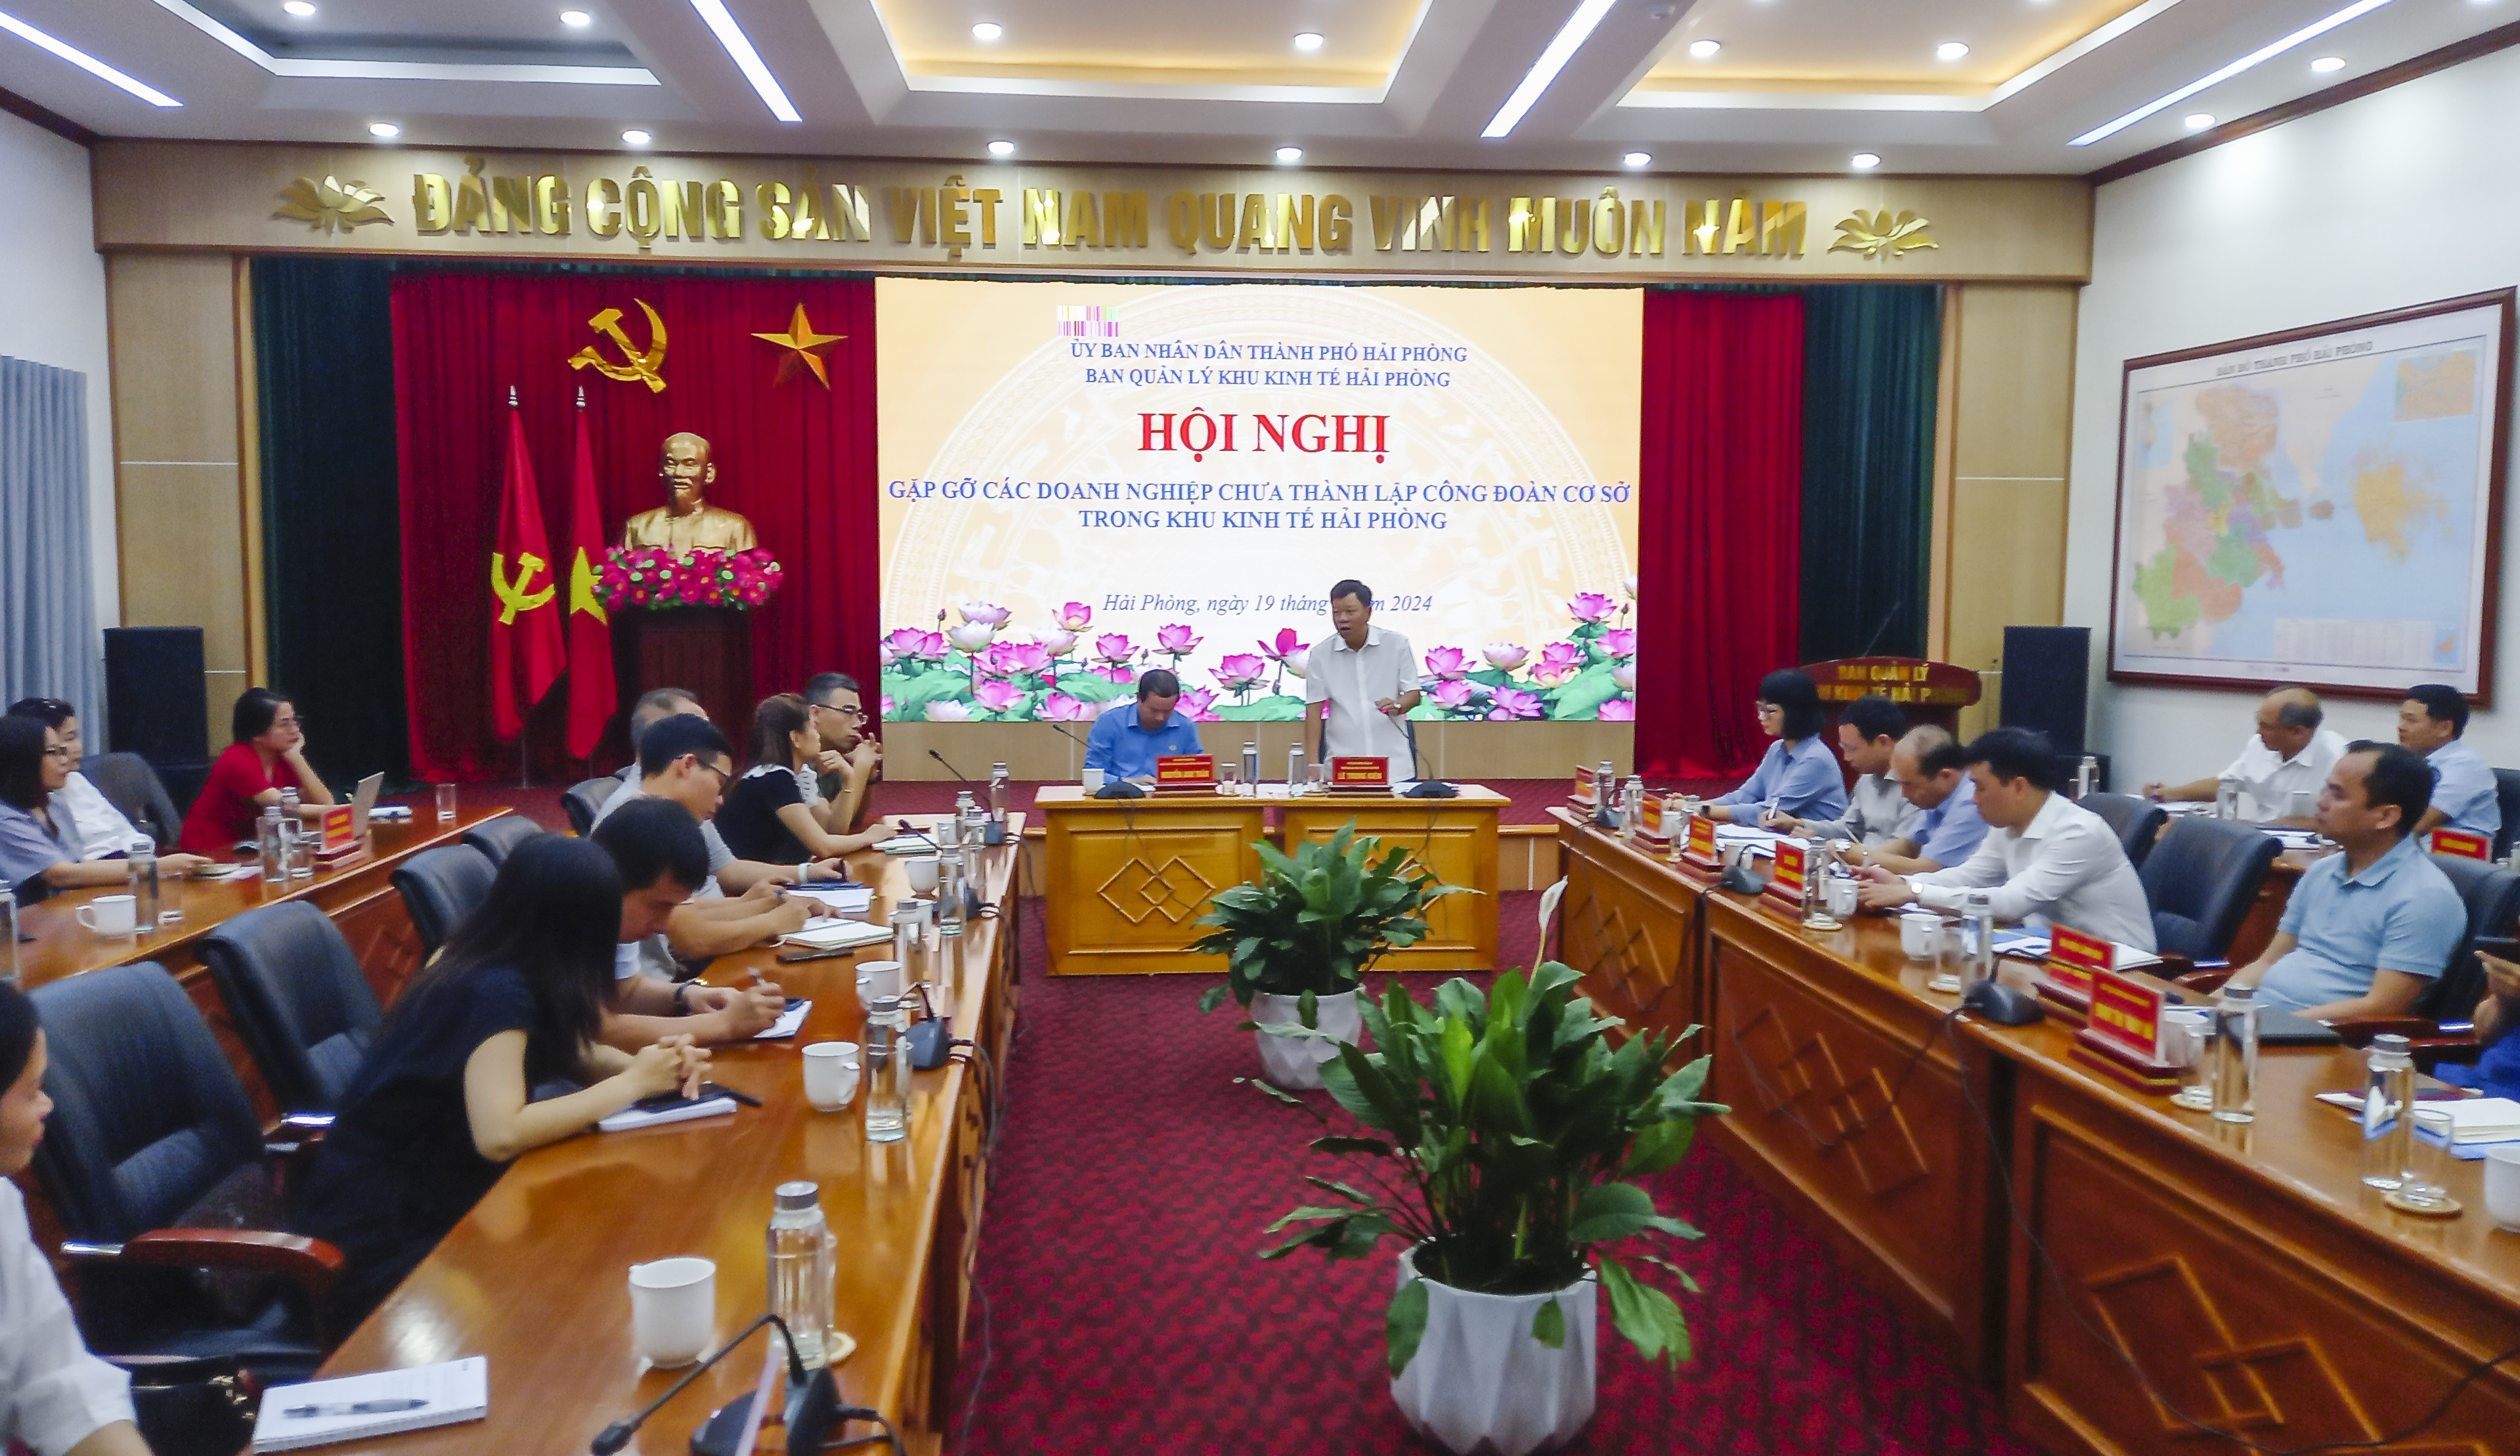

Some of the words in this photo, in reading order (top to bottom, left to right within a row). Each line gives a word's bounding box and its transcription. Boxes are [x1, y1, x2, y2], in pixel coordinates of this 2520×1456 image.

[412, 155, 572, 235] ĐẢNG
[586, 165, 742, 249] CỘNG
[756, 164, 871, 241] SẢN
[889, 174, 1004, 257] VIỆT
[1023, 187, 1148, 248] NAM
[1167, 190, 1354, 256] QUANG
[1370, 194, 1491, 253] VINH
[1508, 185, 1666, 255] MUÔN
[1682, 188, 1808, 255] NĂM
[1070, 338, 1097, 358] ỦY
[1101, 343, 1140, 358] BAN
[1144, 339, 1198, 359] NHÂN
[1203, 339, 1244, 359] DÂN
[1248, 339, 1313, 361] THÀNH
[1319, 340, 1358, 361] PHỐ
[1363, 343, 1397, 361] HẢI
[1401, 343, 1467, 362] PHÒNG
[1085, 368, 1124, 383] BAN
[1130, 365, 1183, 386] QUẢN
[1188, 365, 1212, 385] LÝ
[1218, 370, 1258, 385] KHU
[1265, 371, 1313, 386] KINH
[1317, 366, 1340, 386] TẾ
[1345, 366, 1379, 386] HẢI
[1385, 368, 1450, 387] PHÒNG
[1137, 406, 1238, 463] HỘI
[1252, 414, 1391, 464] NGHỊ
[888, 480, 936, 503] GẶP
[942, 477, 977, 499] GỠ
[983, 477, 1031, 500] CÁC
[1037, 482, 1119, 500] DOANH
[1125, 481, 1213, 505] NGHIỆP
[1218, 482, 1284, 502] CHƯA
[1289, 480, 1368, 502] THÀNH
[1375, 482, 1418, 507] LẬP
[1423, 480, 1488, 503] CÔNG
[1492, 483, 1557, 503] ĐOÀN
[1563, 485, 1596, 503] CƠ
[1601, 481, 1630, 503] SỞ
[1079, 510, 1160, 528] TRONG
[1166, 511, 1215, 528] KHU
[1222, 511, 1280, 529] KINH
[1286, 507, 1314, 529] TẾ
[1320, 507, 1361, 529] HẢI
[1367, 507, 1448, 529] PHÒNG
[1103, 593, 1136, 611] Hải
[1141, 593, 1201, 615] Phòng,
[1206, 595, 1249, 616] ngày
[1254, 595, 1276, 612] 19
[1280, 595, 1329, 616] tháng
[1391, 595, 1433, 612] 2024
